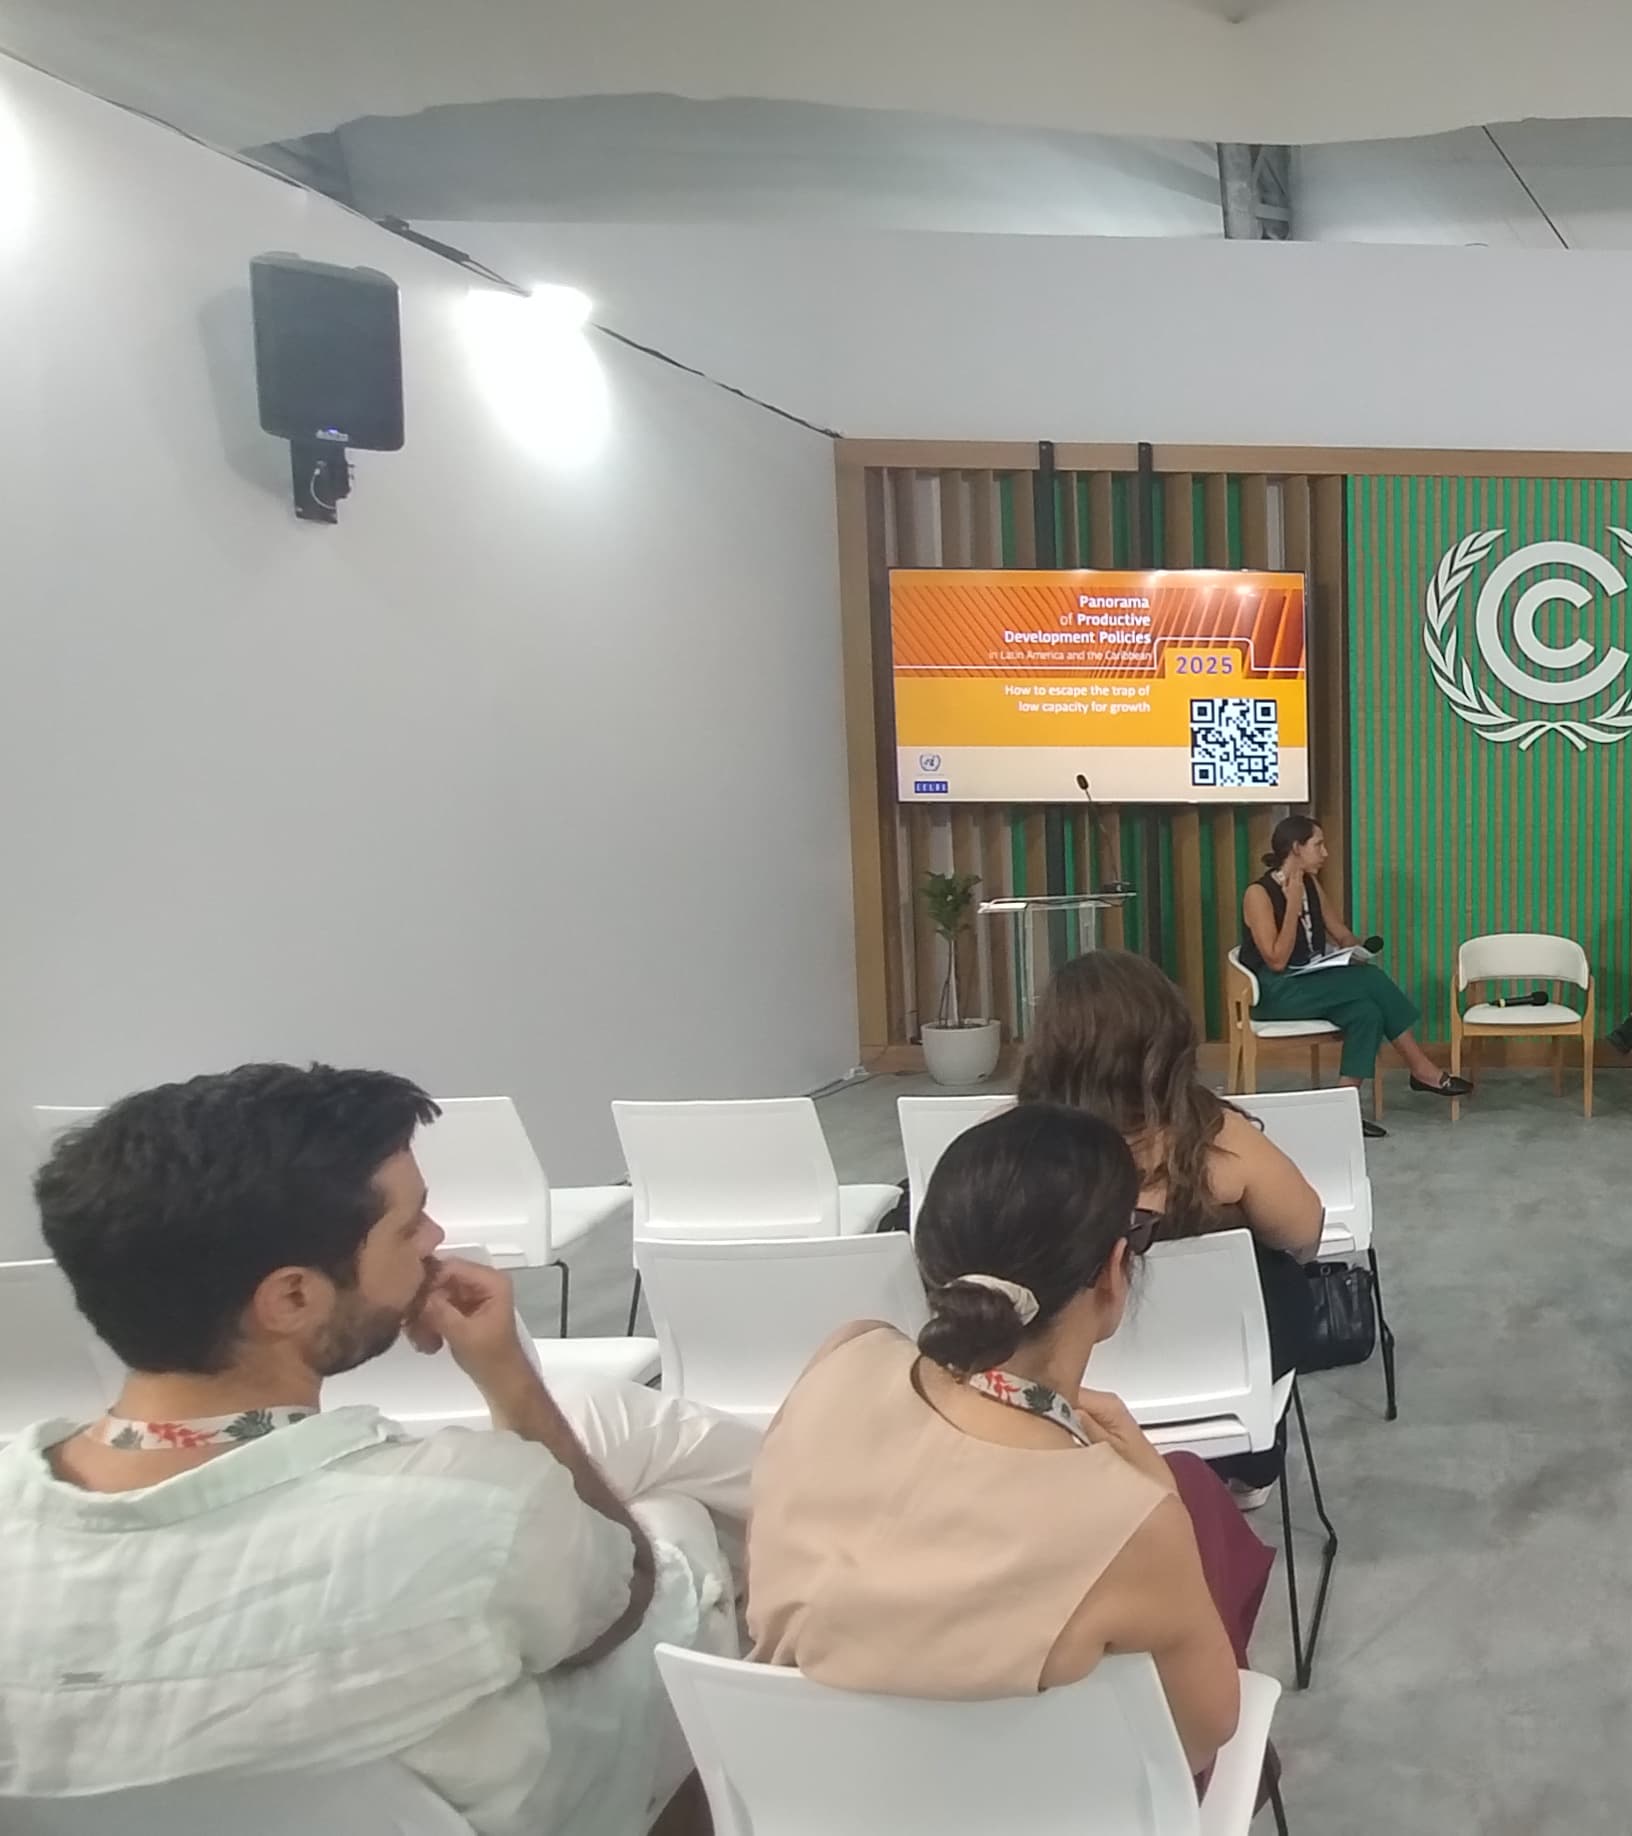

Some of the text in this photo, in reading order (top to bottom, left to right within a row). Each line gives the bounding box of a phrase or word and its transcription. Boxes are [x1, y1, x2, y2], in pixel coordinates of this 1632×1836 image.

[1079, 595, 1150, 608] Panorama
[1060, 612, 1151, 627] of Productive
[1004, 630, 1151, 645] Development Policies
[1027, 650, 1064, 660] America
[1066, 651, 1085, 660] and
[1175, 656, 1233, 675] 2025
[1004, 684, 1150, 699] How to escape the trap of
[1018, 700, 1151, 715] low capacity for growth
